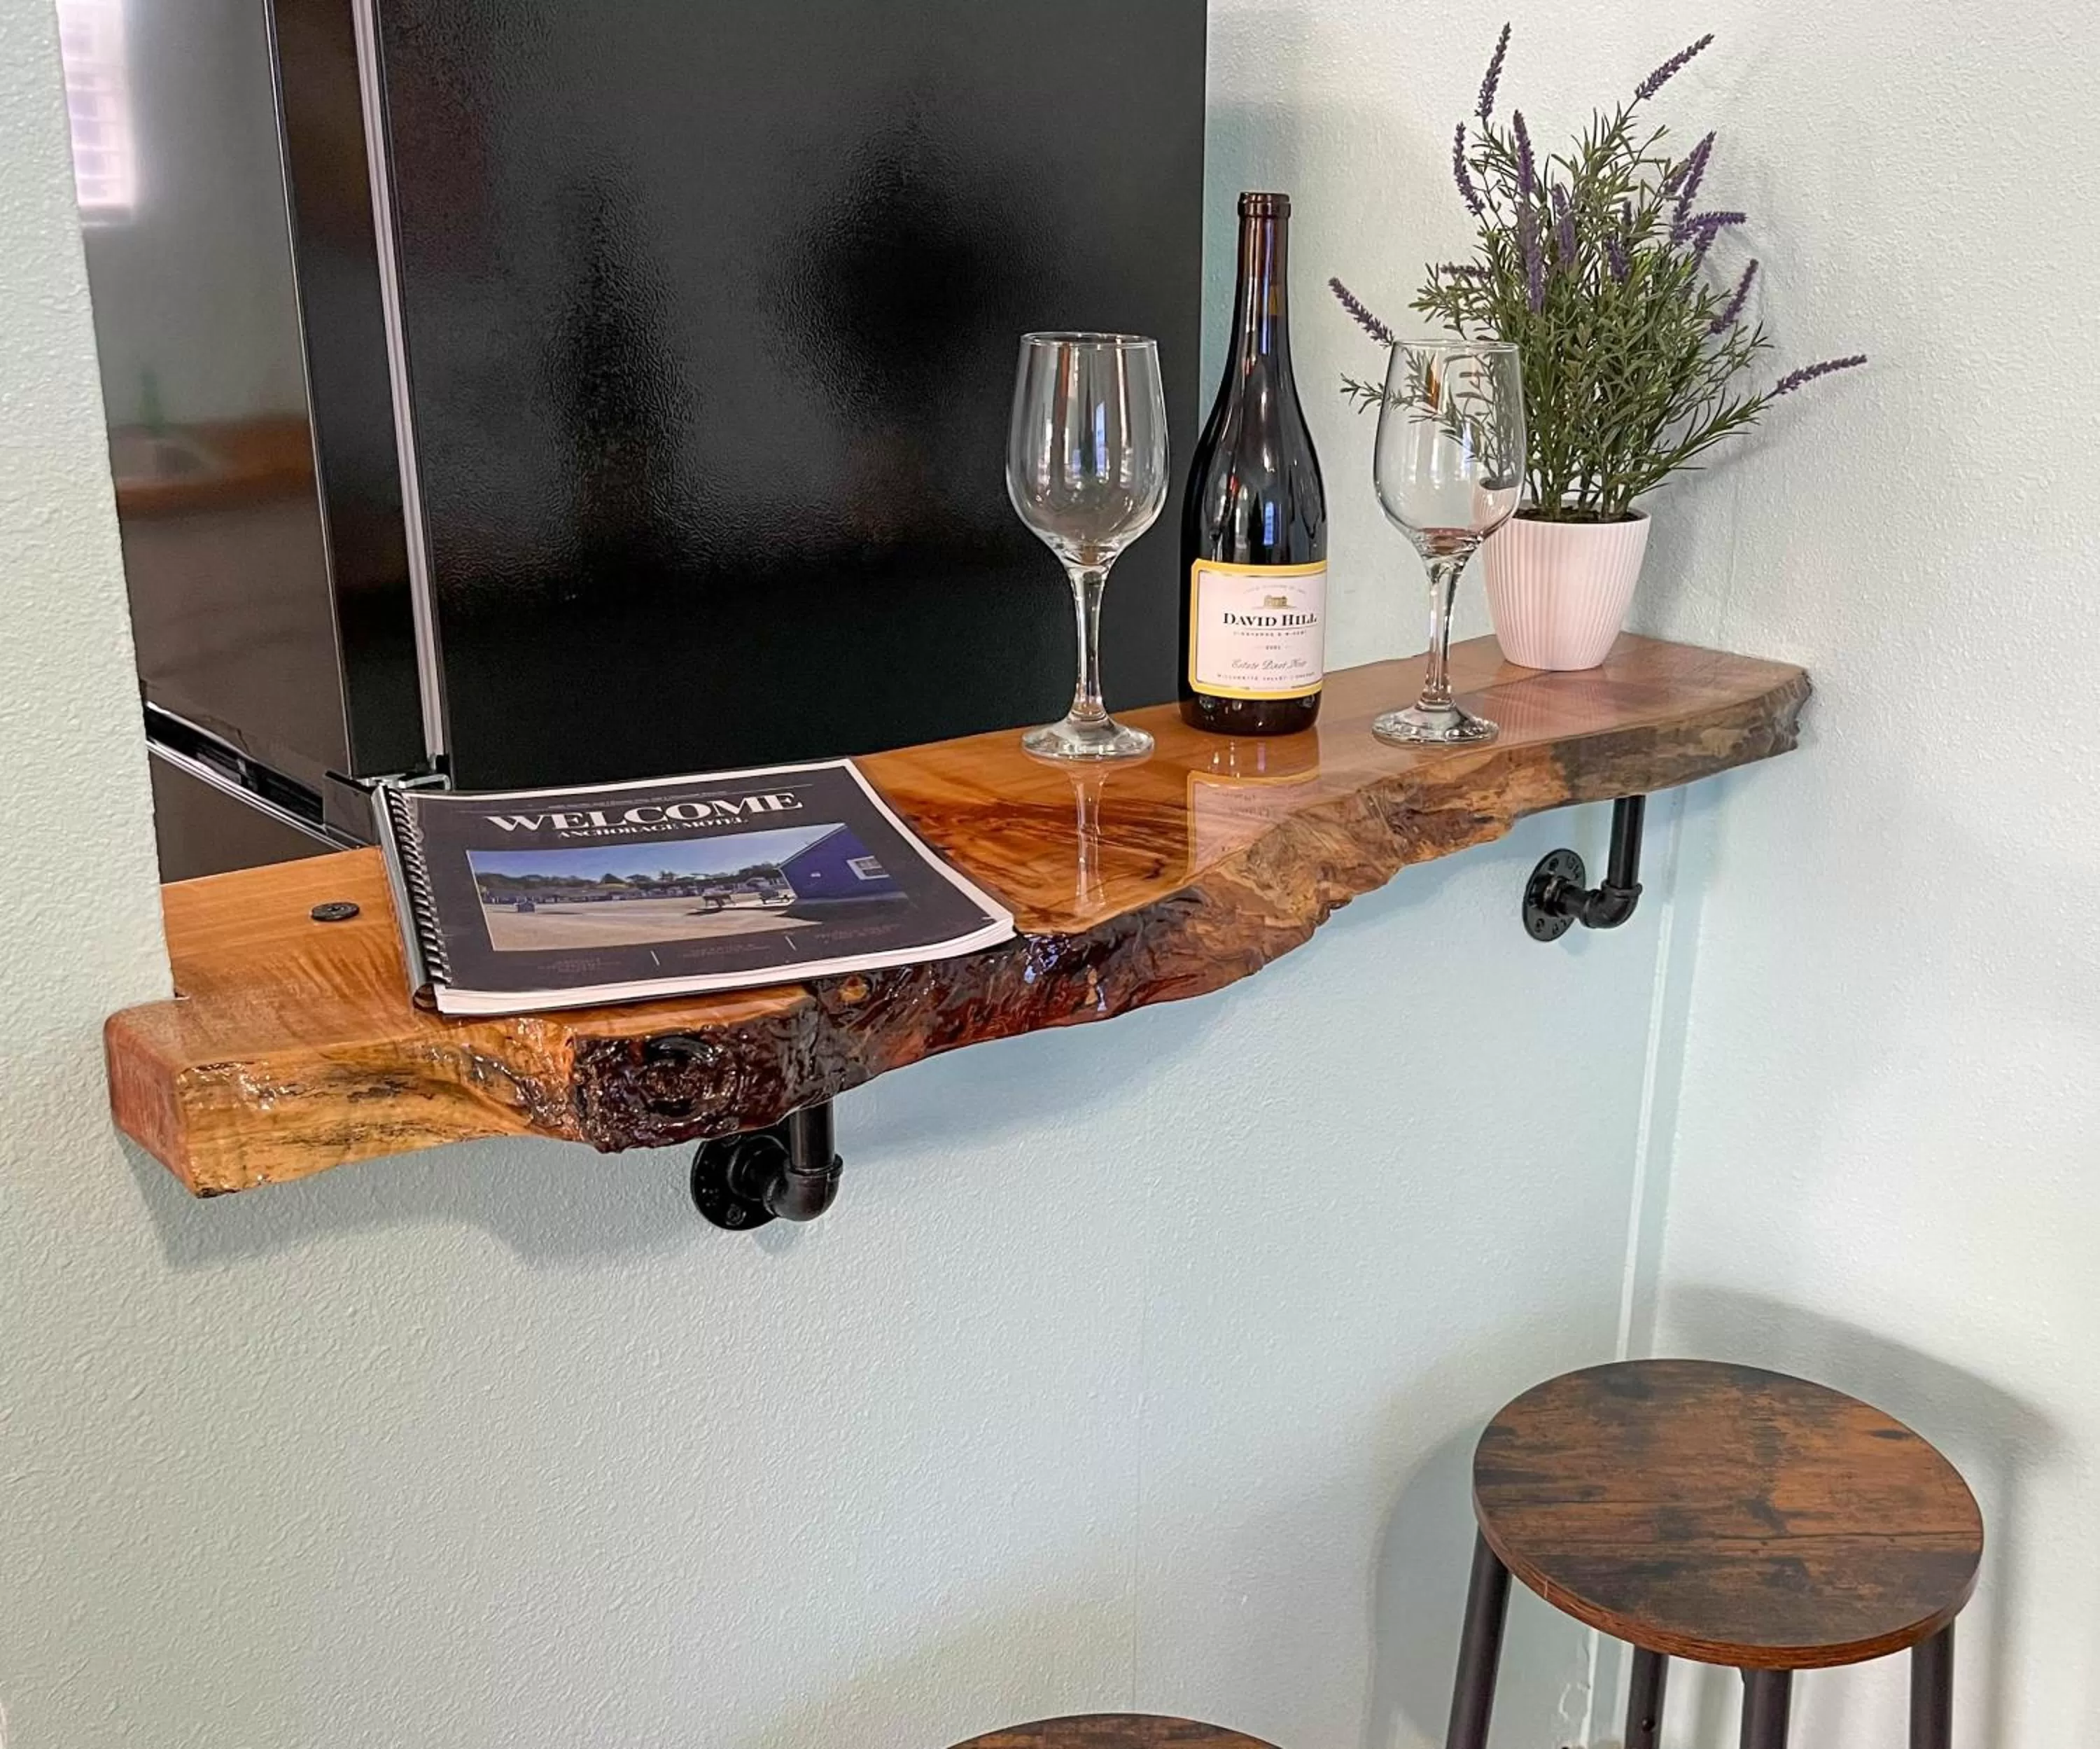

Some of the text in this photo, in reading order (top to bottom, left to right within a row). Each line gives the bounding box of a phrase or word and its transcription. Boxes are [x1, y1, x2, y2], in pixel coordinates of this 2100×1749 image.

[1223, 613, 1317, 627] DAVID HILL
[484, 792, 803, 832] WELCOME
